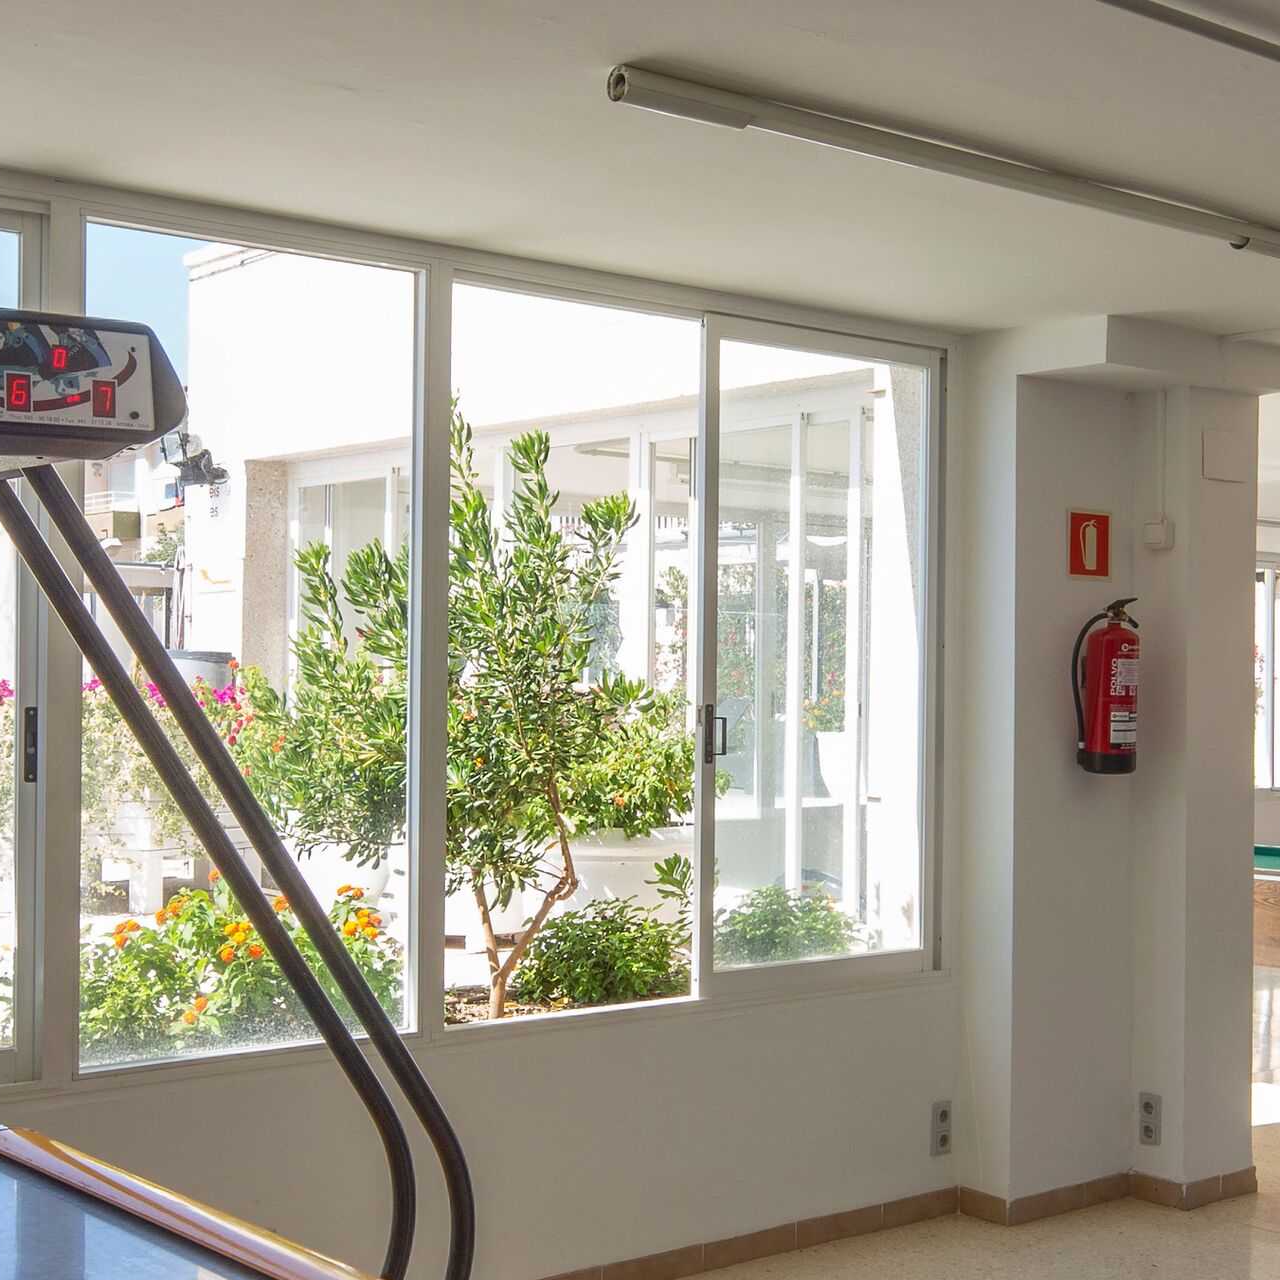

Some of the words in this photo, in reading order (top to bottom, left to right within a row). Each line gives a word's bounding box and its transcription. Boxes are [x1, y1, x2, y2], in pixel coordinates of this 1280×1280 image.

[52, 347, 67, 368] 0
[11, 379, 26, 405] 6
[98, 386, 112, 411] 7
[1110, 658, 1118, 696] POLVO
